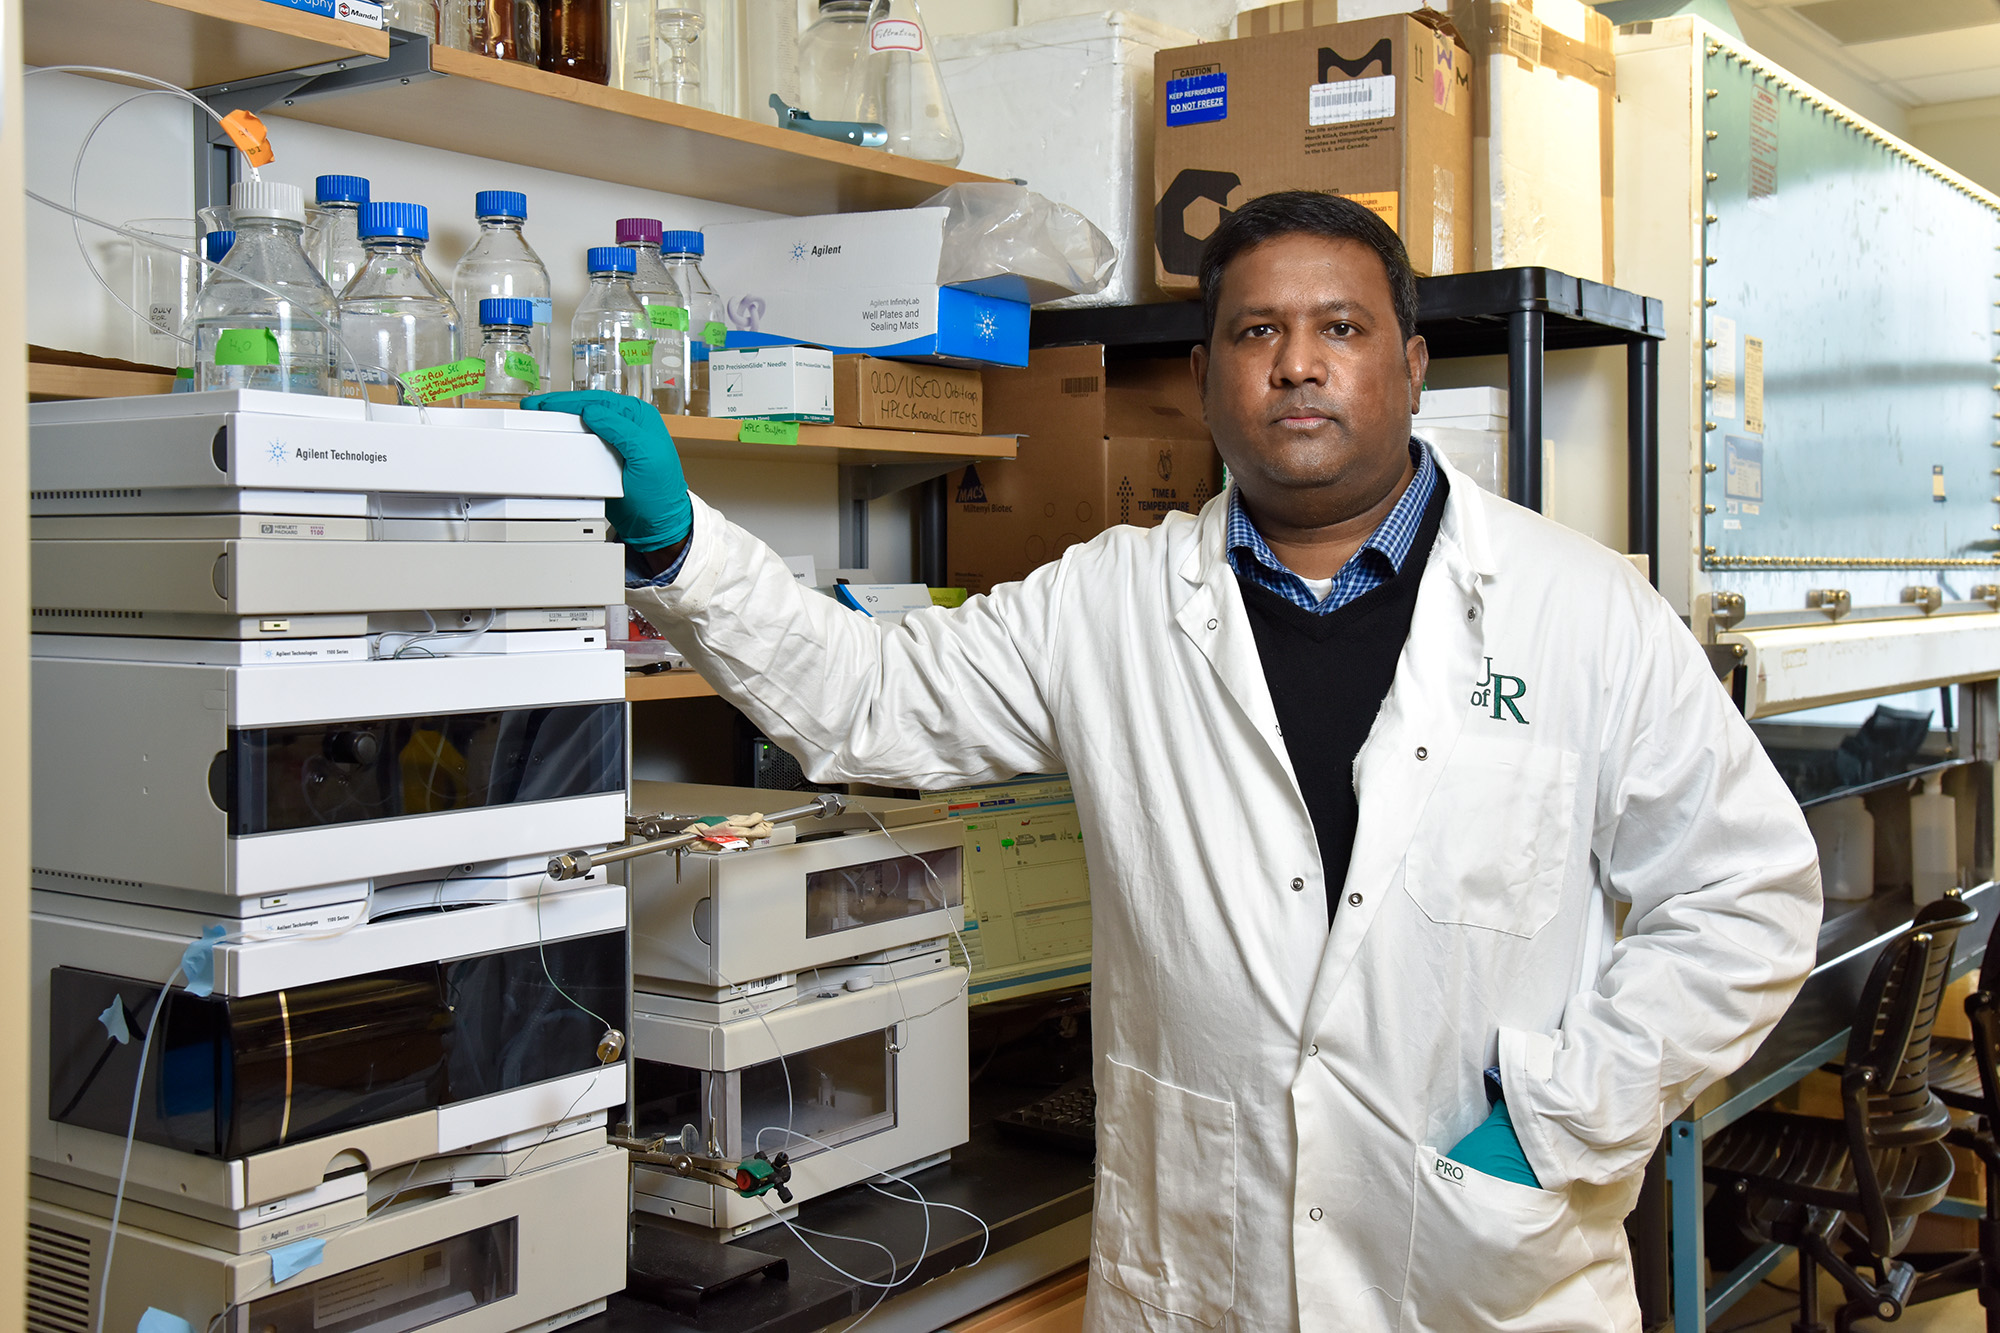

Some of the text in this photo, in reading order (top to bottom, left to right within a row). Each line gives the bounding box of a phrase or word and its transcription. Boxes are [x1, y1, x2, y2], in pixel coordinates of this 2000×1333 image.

[351, 9, 379, 21] Mandel
[1180, 66, 1212, 77] CAUTION
[1168, 85, 1226, 101] KEEP REFRIGERATED
[1170, 97, 1224, 114] DO NOT FREEZE
[1370, 126, 1395, 134] Germany
[811, 245, 841, 257] Agilent
[870, 298, 920, 307] Agilent InfinityLab
[862, 309, 919, 320] Well Plates and
[870, 321, 919, 333] Sealing Mats
[871, 371, 941, 399] OLD/USED
[950, 411, 978, 428] ITEMS
[744, 422, 761, 434] HPLC
[295, 447, 388, 464] Agilent Technologies
[959, 485, 984, 503] MACS
[1152, 488, 1176, 498] TIME &
[963, 504, 1013, 514] Miltenyi Biotec
[1137, 501, 1190, 511] TEMPERATURE
[1490, 673, 1530, 724] R
[292, 919, 319, 928] Technologies
[1435, 1158, 1464, 1180] PRO
[271, 1230, 289, 1240] Agilent
